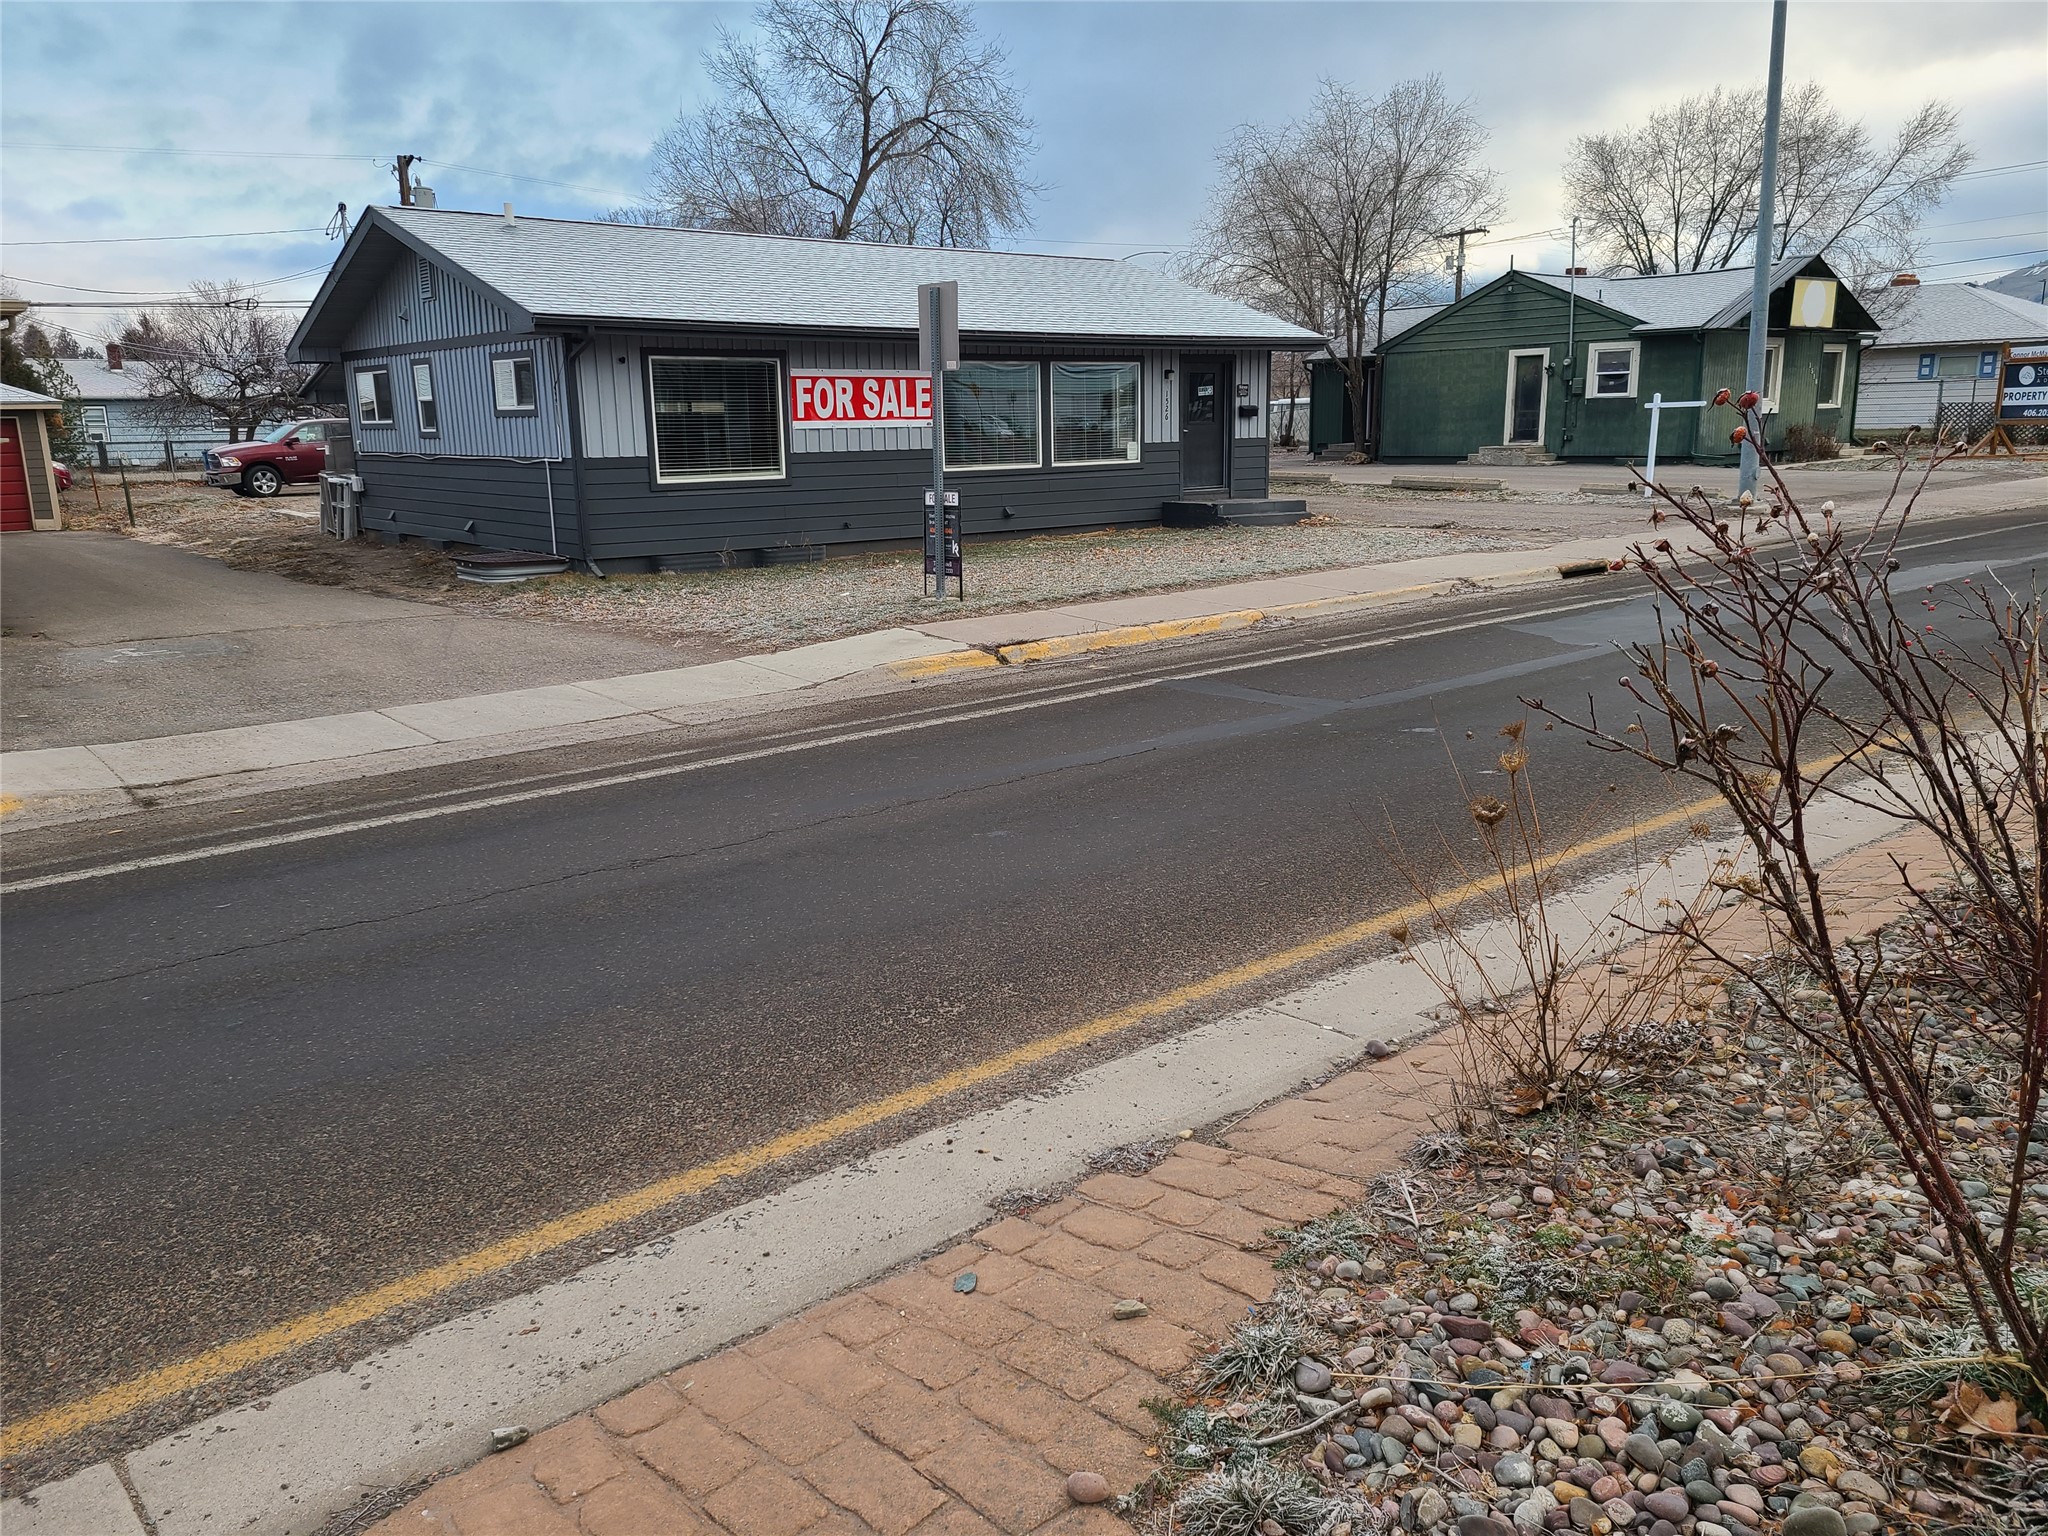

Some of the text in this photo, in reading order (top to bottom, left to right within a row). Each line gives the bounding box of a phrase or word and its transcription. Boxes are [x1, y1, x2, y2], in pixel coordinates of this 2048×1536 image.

[795, 378, 932, 419] FOR SALE
[2003, 391, 2048, 401] PROPERTY
